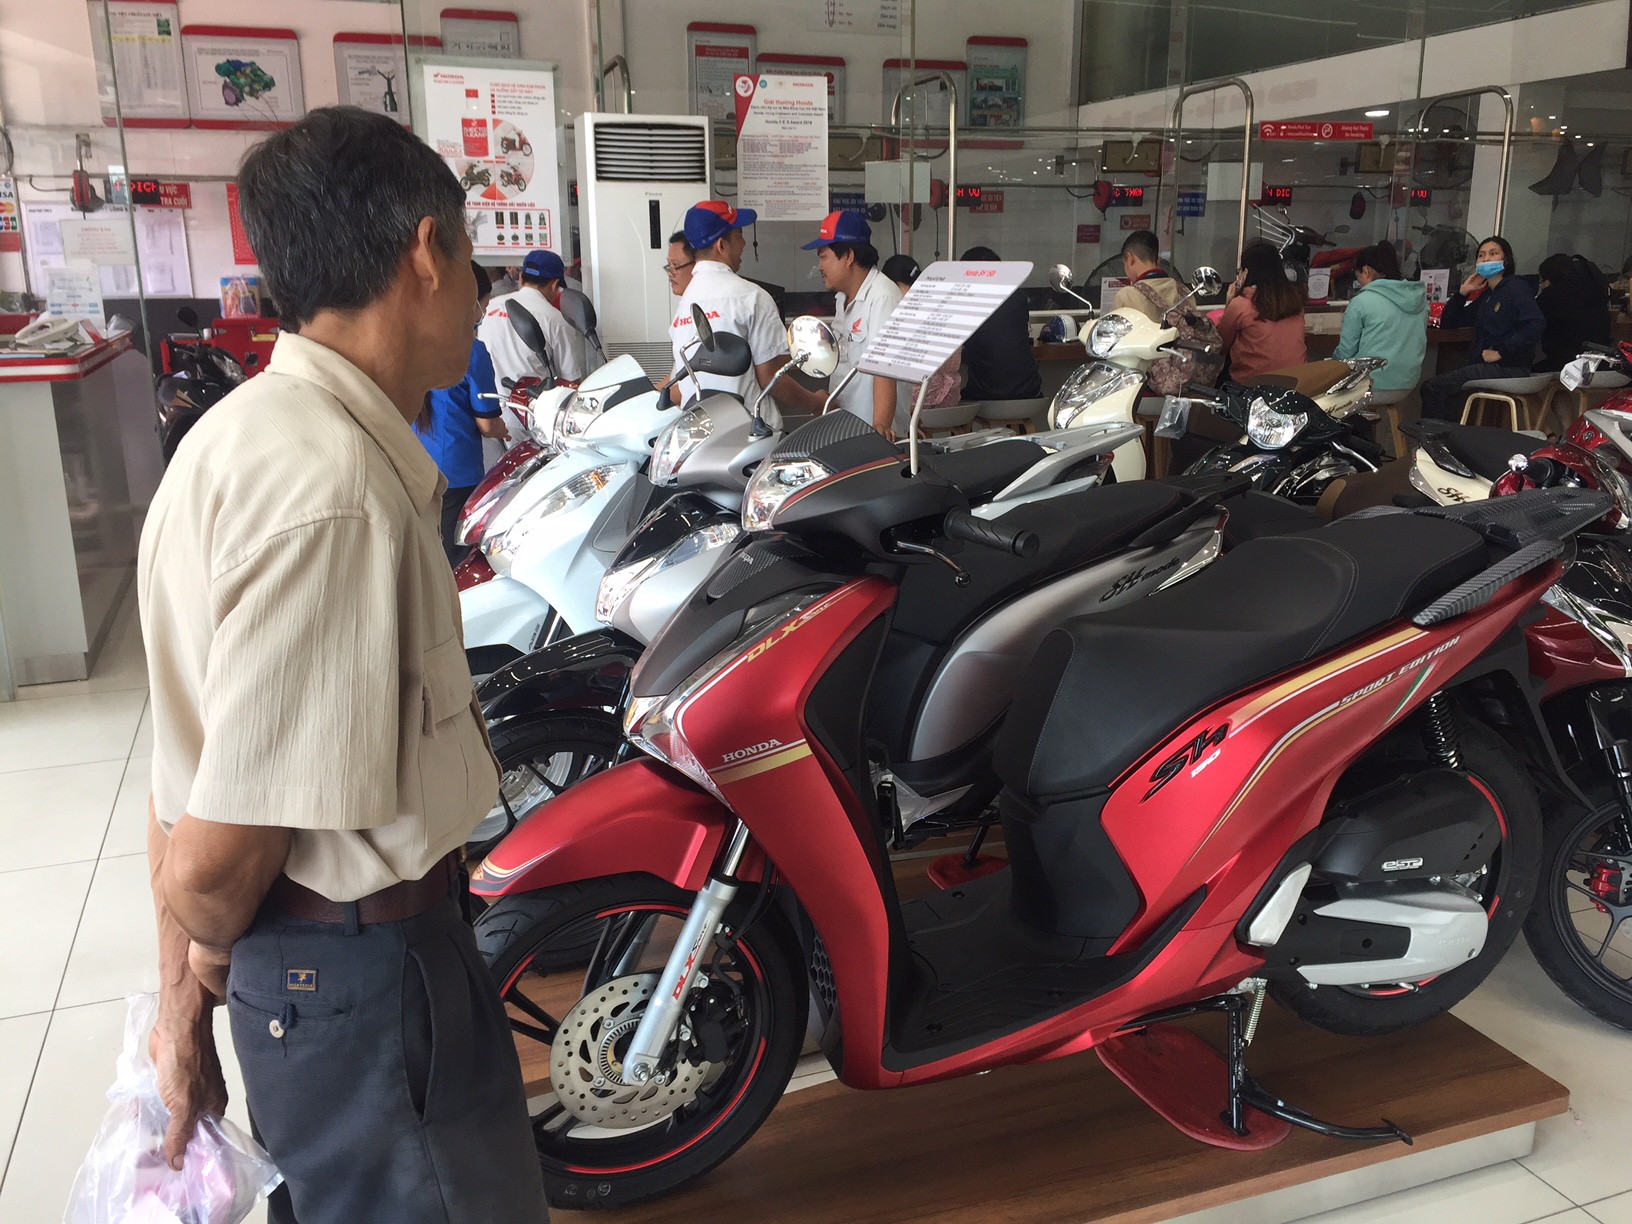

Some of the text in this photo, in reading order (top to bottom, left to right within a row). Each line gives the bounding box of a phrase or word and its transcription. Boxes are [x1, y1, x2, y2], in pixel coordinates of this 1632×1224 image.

[680, 311, 720, 326] HODA
[747, 618, 800, 663] DLX
[1340, 636, 1461, 705] SPORT EDITION
[722, 737, 783, 764] HONDA
[672, 952, 696, 1001] DLX
